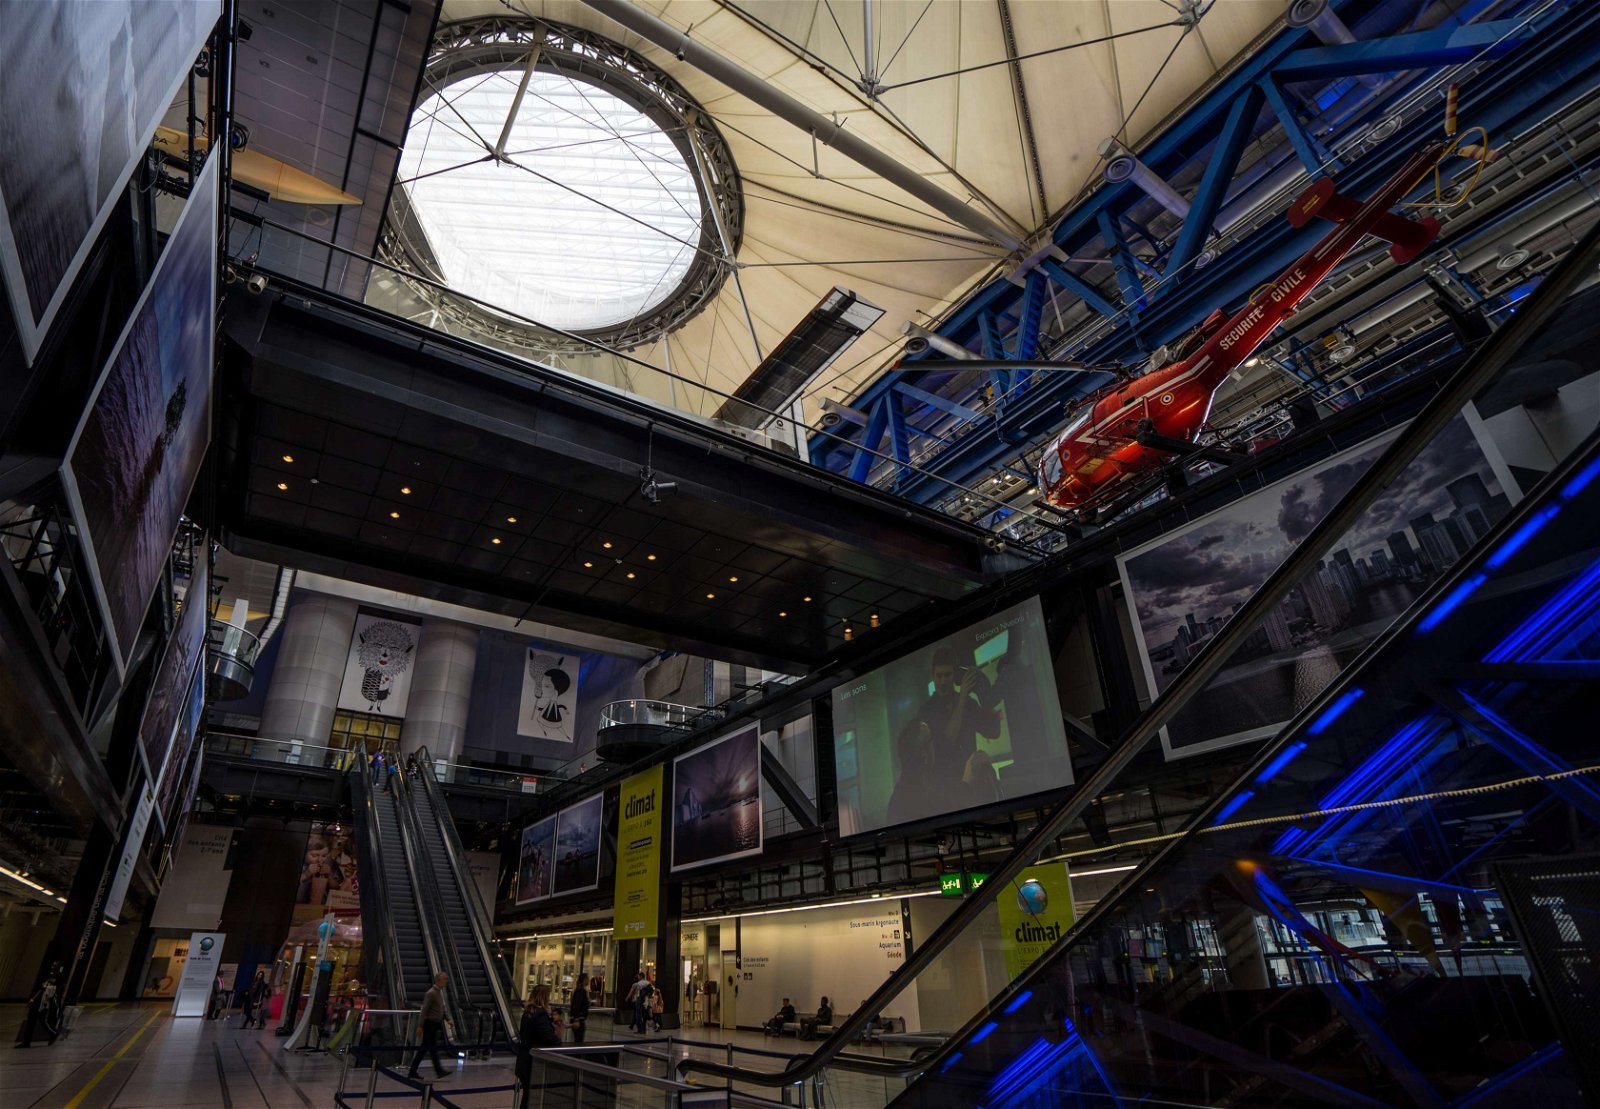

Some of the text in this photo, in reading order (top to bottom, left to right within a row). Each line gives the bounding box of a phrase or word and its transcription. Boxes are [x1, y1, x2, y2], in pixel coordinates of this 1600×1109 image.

[1271, 268, 1306, 302] CIVILE
[840, 684, 867, 701] Les sons
[625, 788, 655, 820] climat
[875, 919, 899, 928] Argonaute
[1015, 921, 1061, 943] climat
[879, 942, 902, 950] Aquarium
